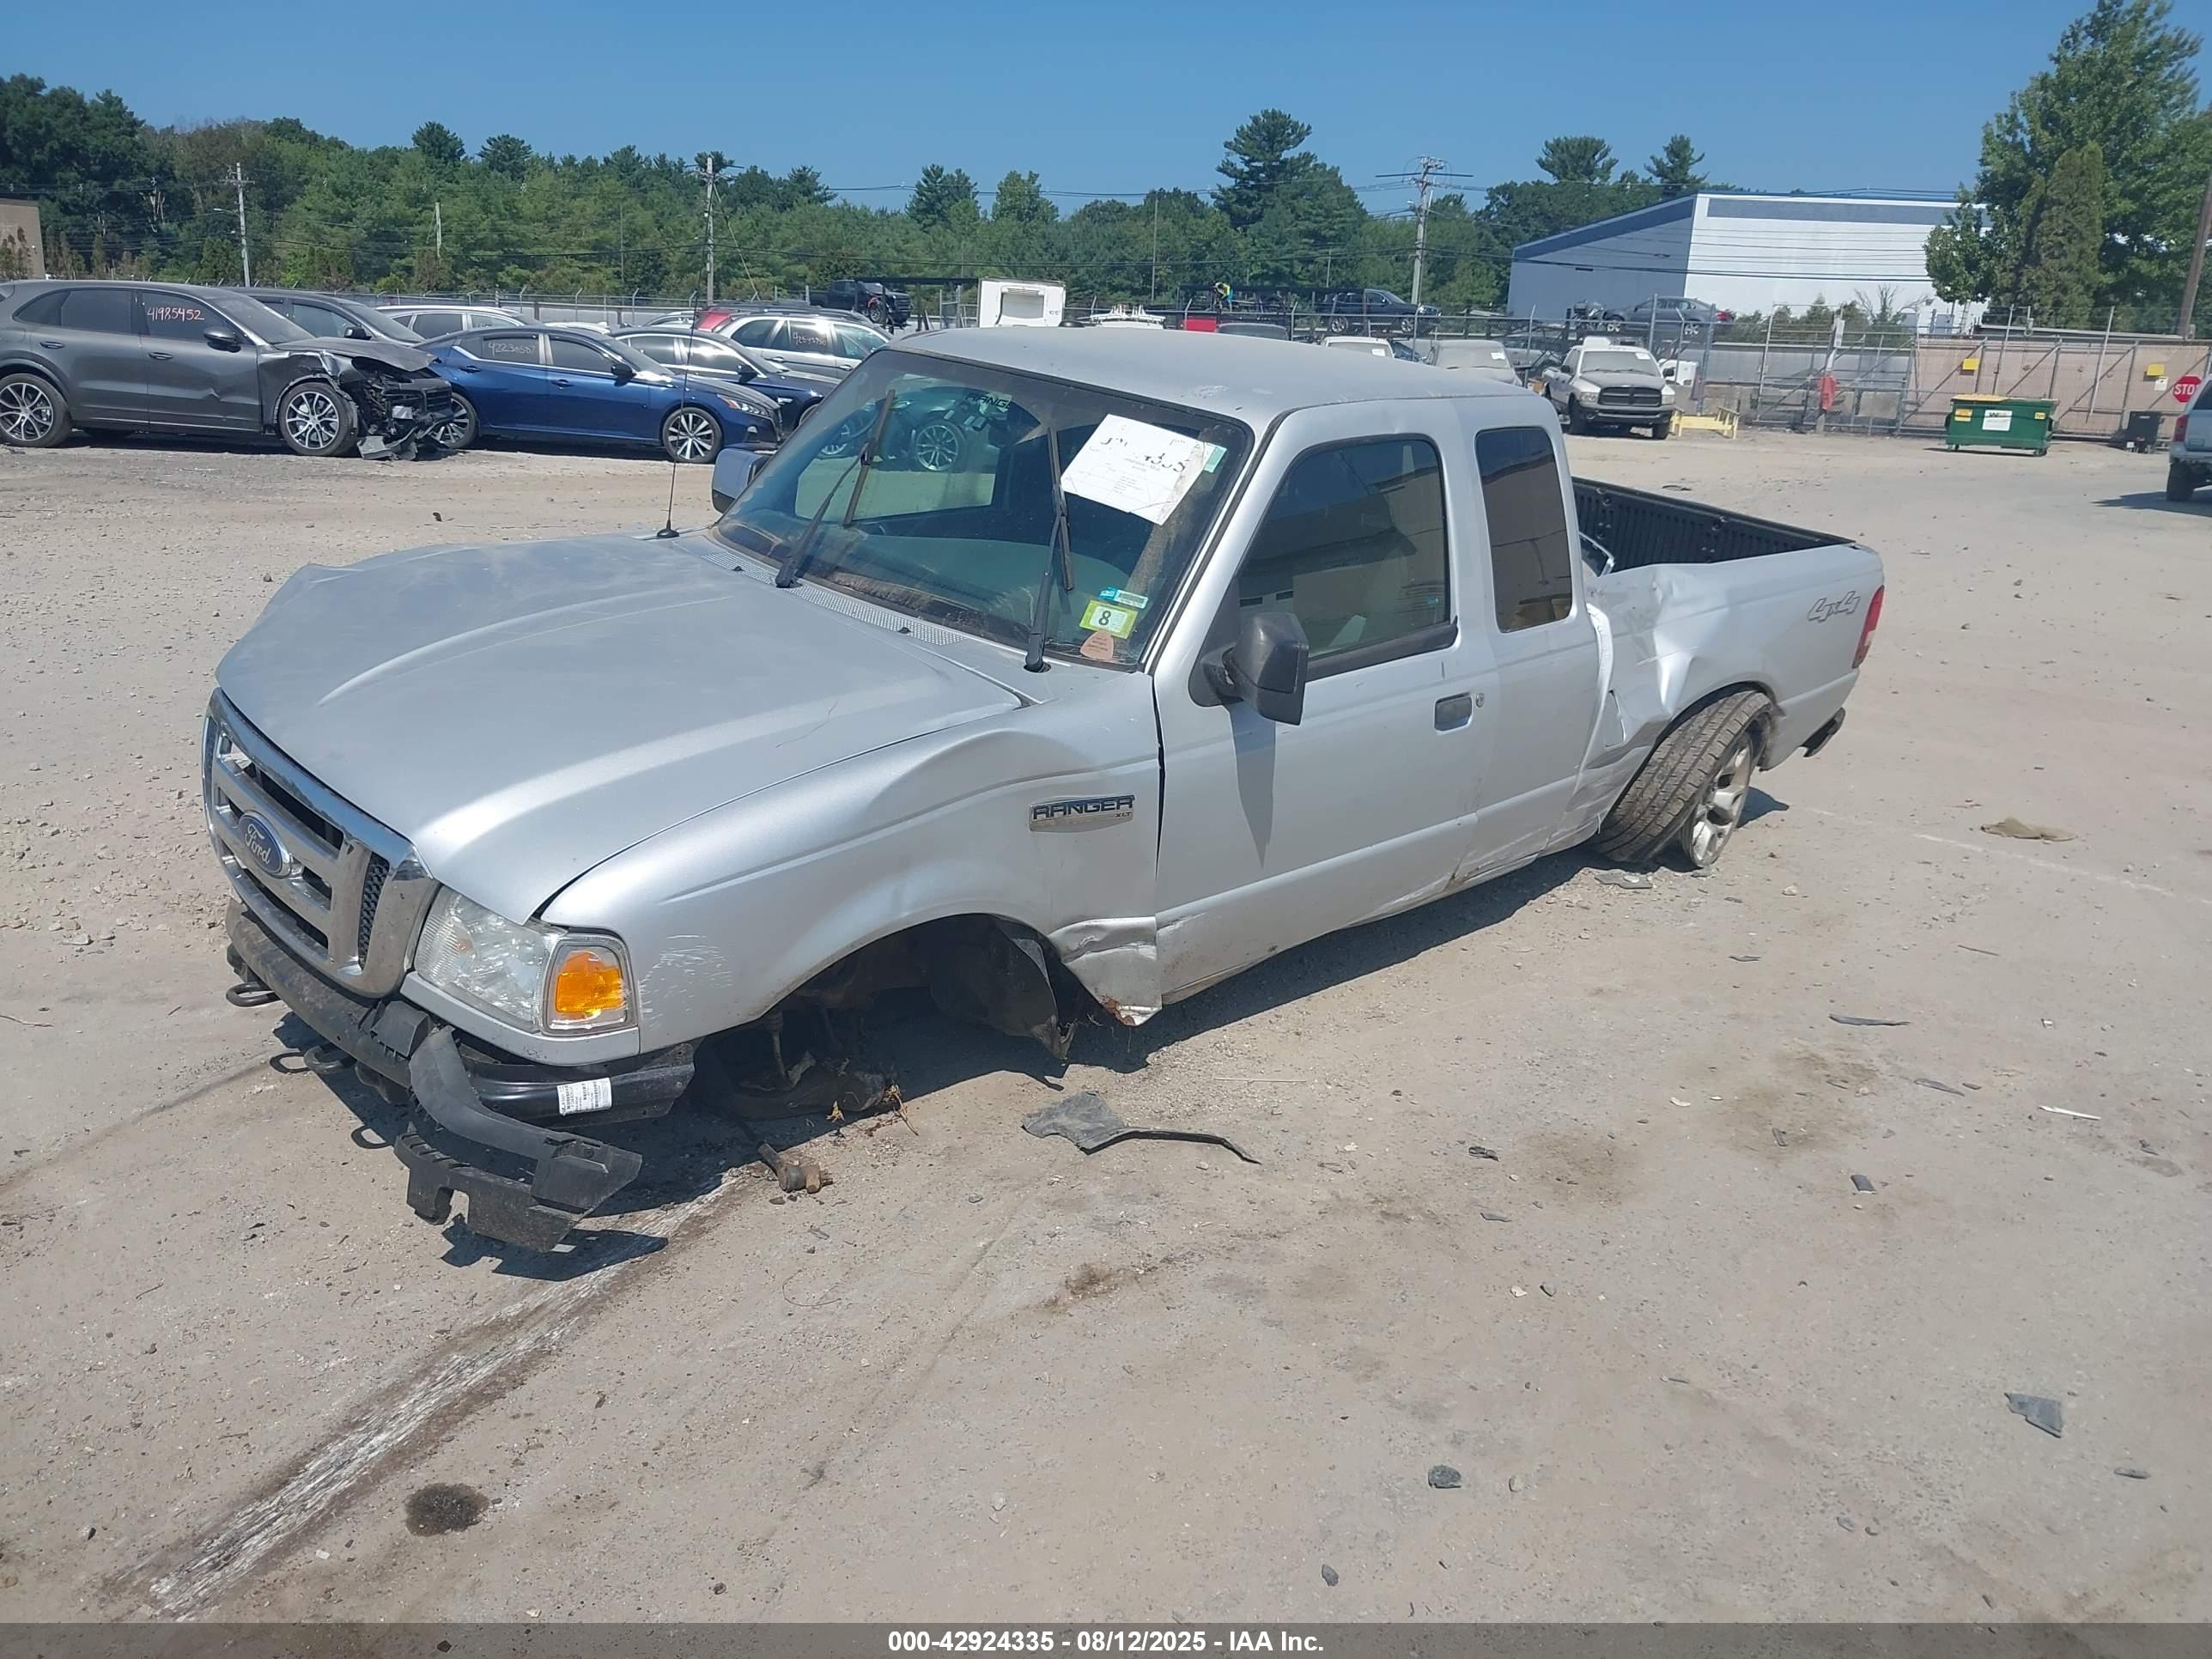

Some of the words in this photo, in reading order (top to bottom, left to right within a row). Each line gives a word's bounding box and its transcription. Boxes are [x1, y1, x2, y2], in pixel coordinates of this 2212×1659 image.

[147, 307, 205, 323] 41985452
[2174, 384, 2197, 395] STO
[1807, 590, 1861, 623] 4x4
[1098, 610, 1112, 626] 8
[1032, 794, 1135, 820] RANGER
[245, 823, 271, 865] Ford
